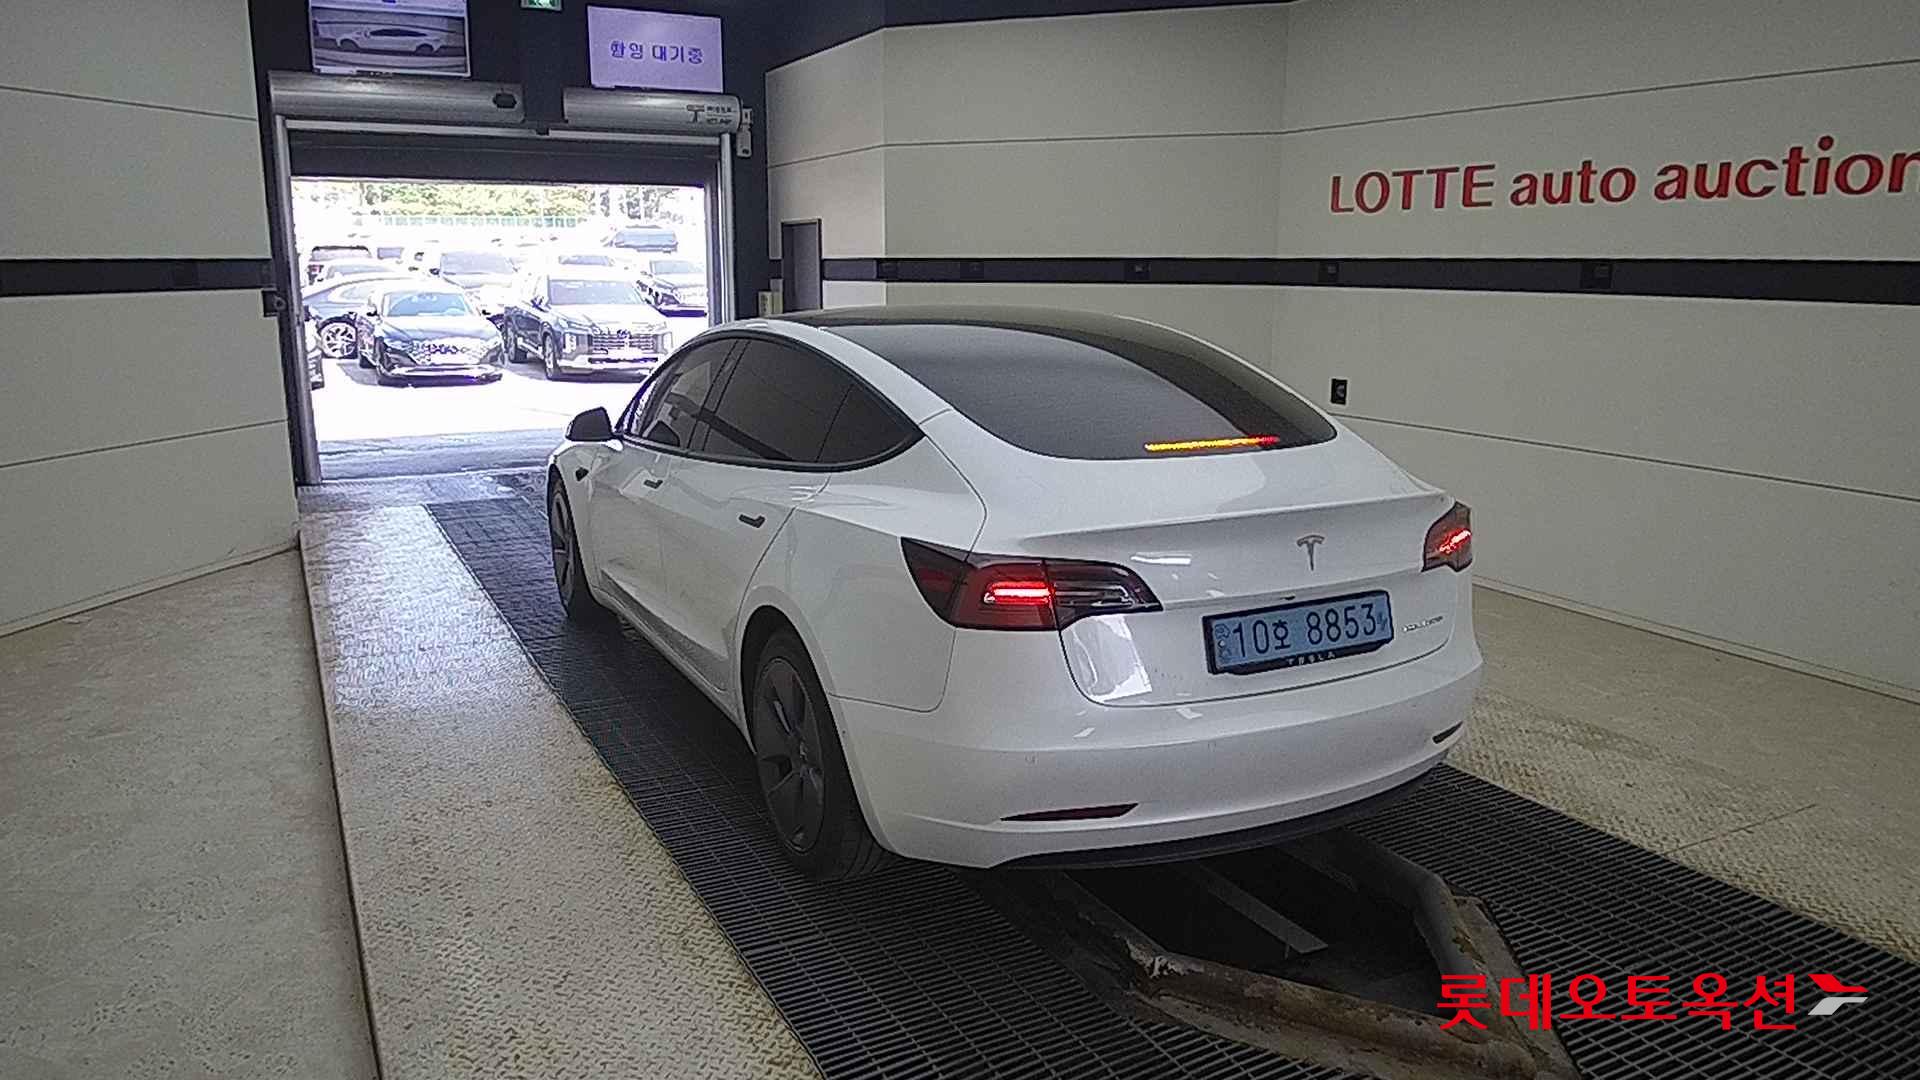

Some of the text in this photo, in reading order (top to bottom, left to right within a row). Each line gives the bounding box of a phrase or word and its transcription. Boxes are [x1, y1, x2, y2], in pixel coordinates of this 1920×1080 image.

[652, 45, 704, 64] 대기중
[1331, 164, 1496, 213] LOTTE
[1511, 159, 1637, 206] auto
[1233, 619, 1291, 658] 10호
[1306, 603, 1377, 645] 8853
